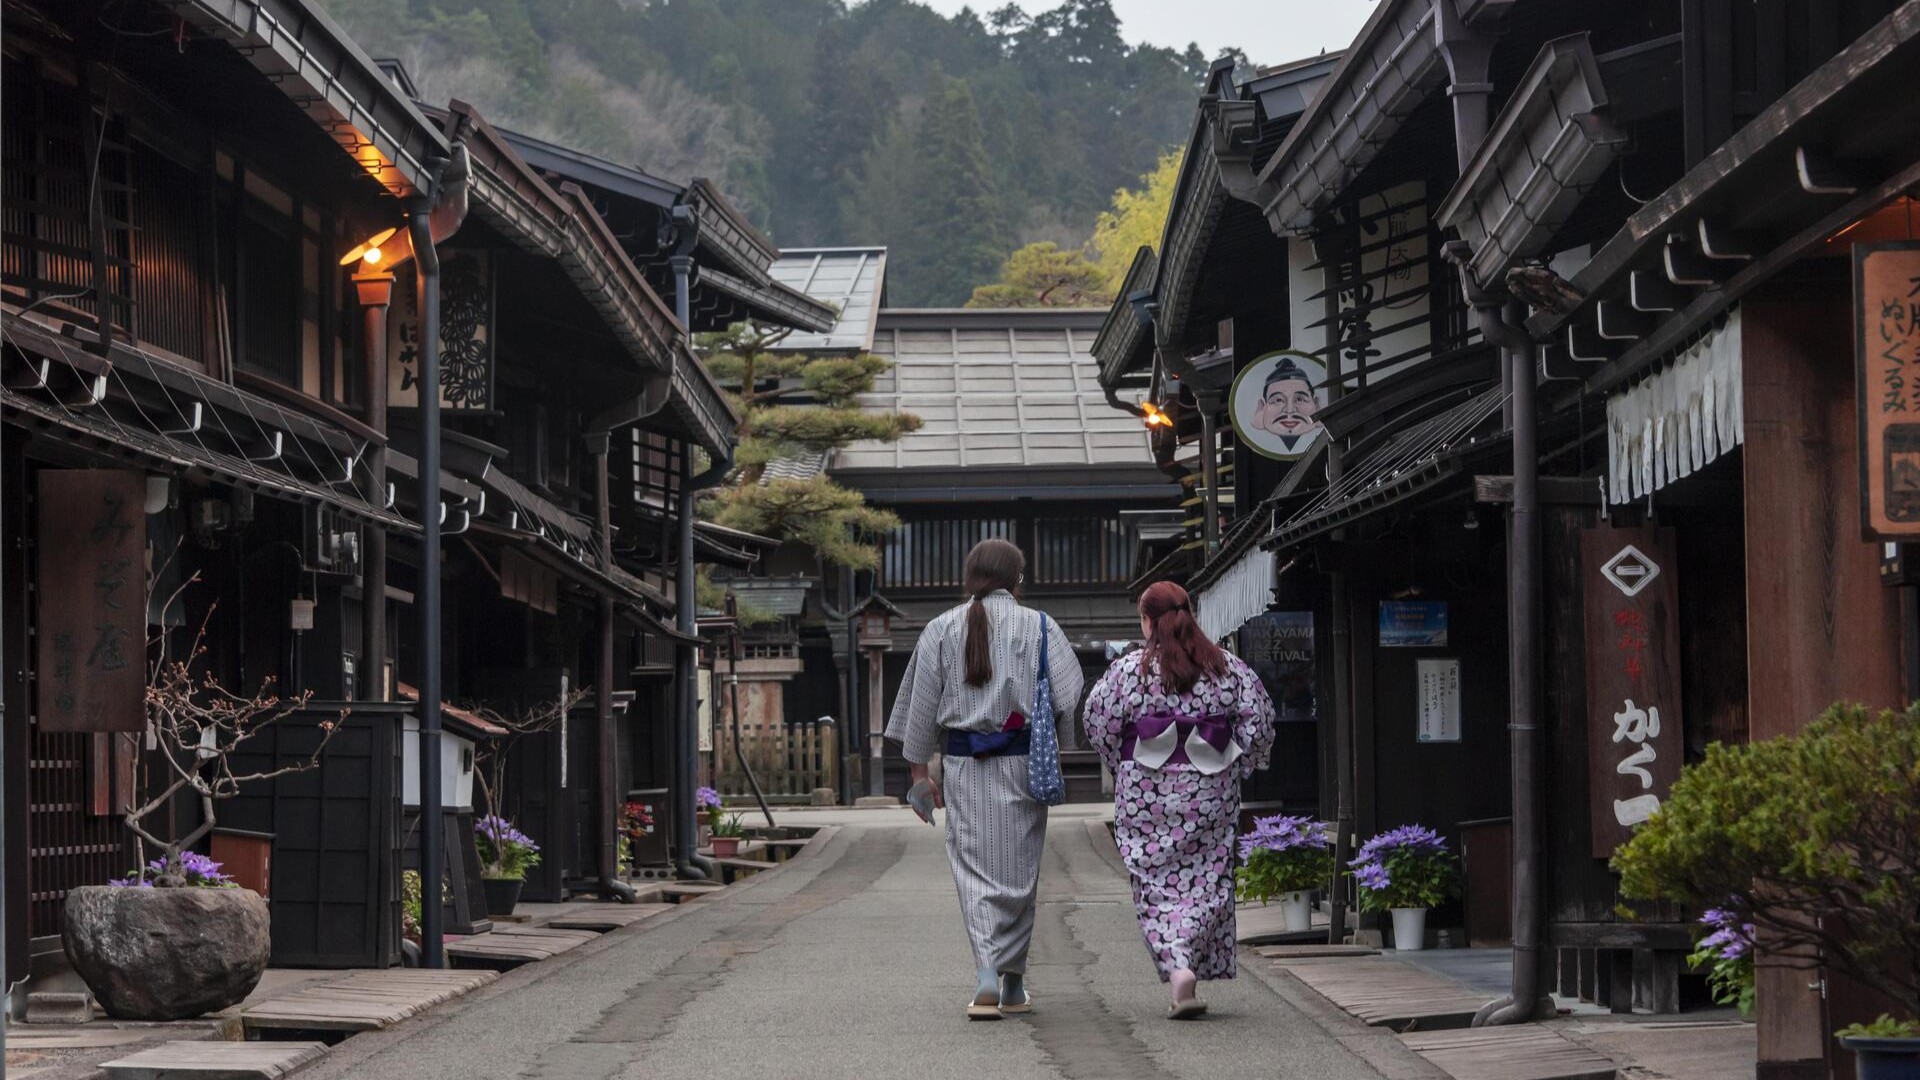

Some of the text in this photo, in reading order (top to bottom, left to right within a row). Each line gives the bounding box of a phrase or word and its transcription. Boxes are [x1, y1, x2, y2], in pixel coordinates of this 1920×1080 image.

[1881, 299, 1907, 414] ぬいぐるみ
[1246, 639, 1282, 651] JAZZ
[1246, 650, 1311, 662] FESTIVAL
[1612, 699, 1661, 826] かく一
